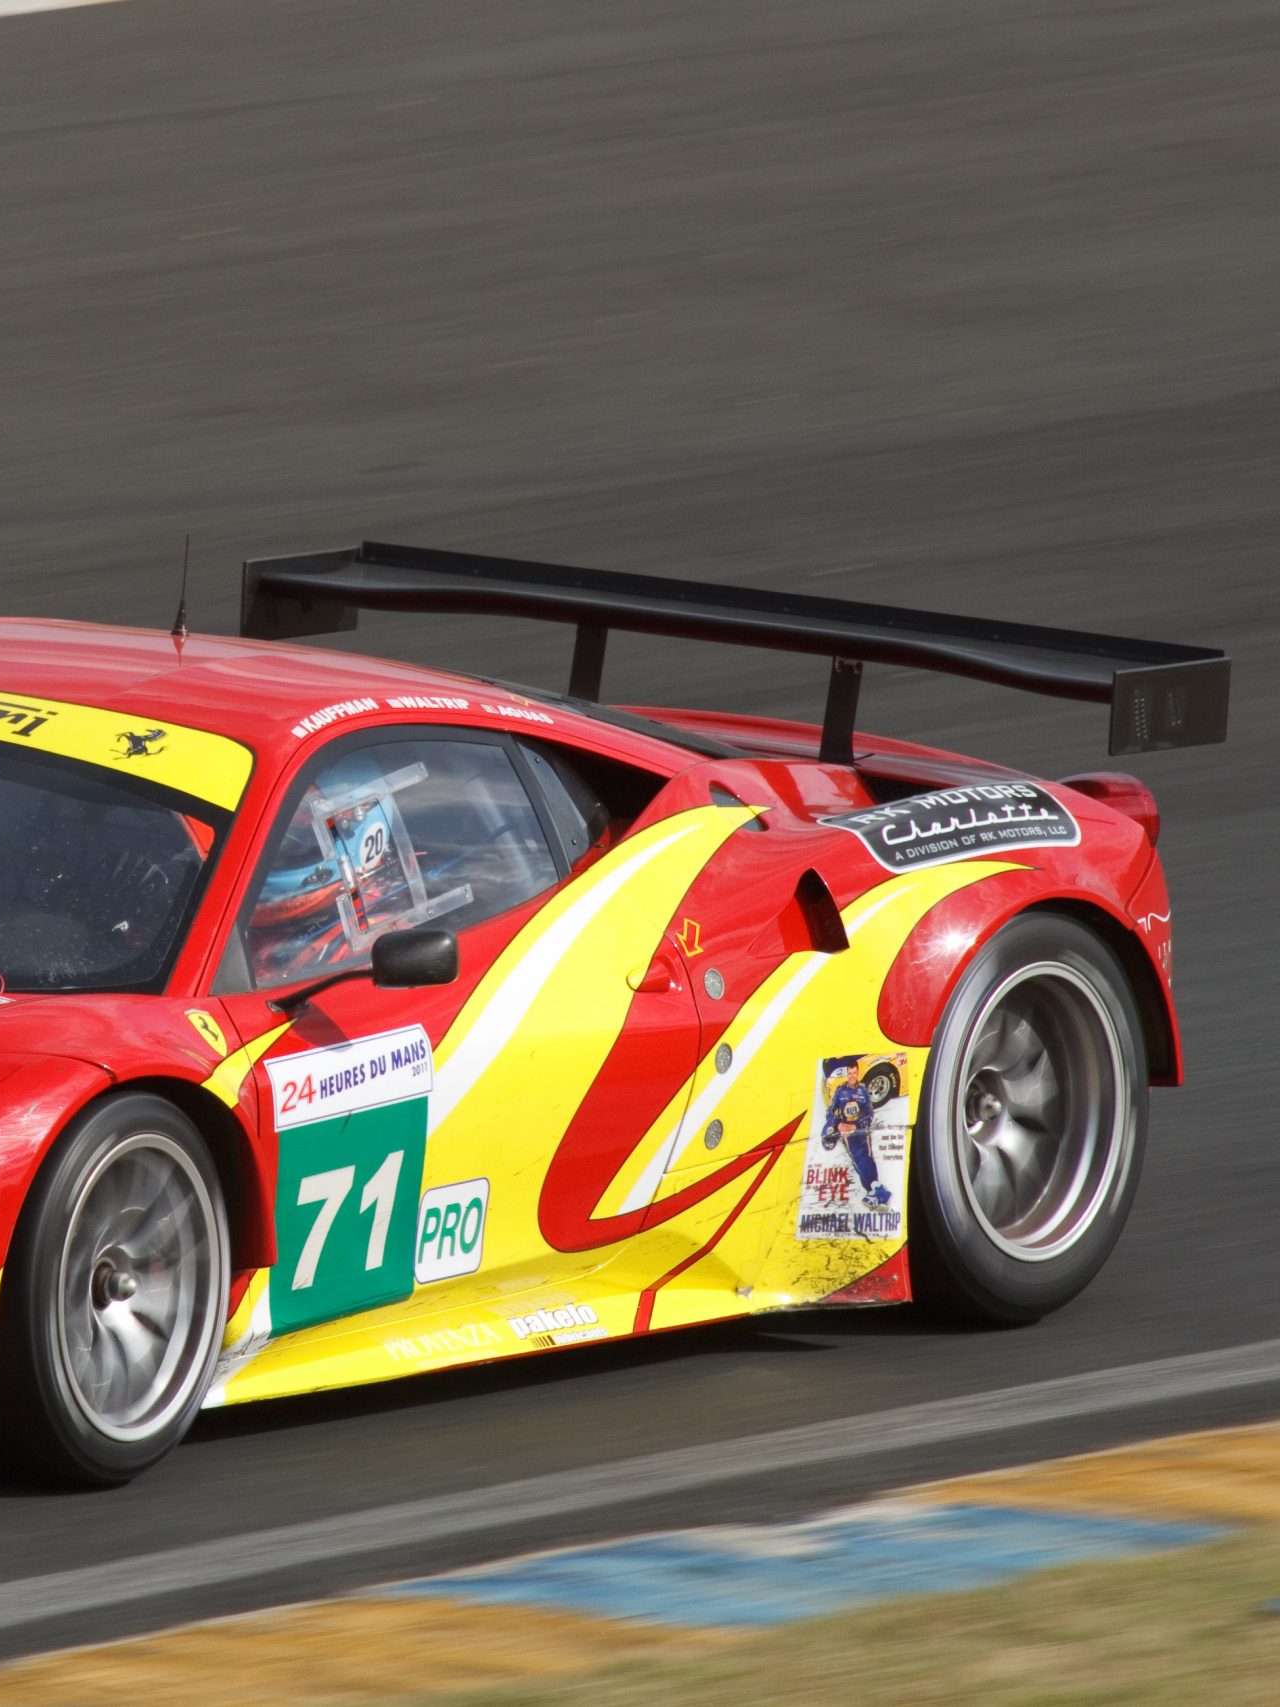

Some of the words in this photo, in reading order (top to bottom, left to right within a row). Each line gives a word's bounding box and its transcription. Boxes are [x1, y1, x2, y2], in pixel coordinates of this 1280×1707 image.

[302, 697, 379, 733] KAUFFMAN
[399, 697, 470, 710] WALTRIP
[850, 804, 910, 824] RK
[917, 785, 1037, 809] MOTORS
[882, 803, 1059, 845] Charlotte
[895, 851, 905, 862] A
[907, 840, 959, 859] DIVISION
[961, 834, 976, 846] OF
[980, 831, 997, 843] RK
[999, 826, 1047, 841] MOTORS,
[1049, 824, 1068, 836] LLC
[364, 828, 384, 863] 20
[280, 1072, 317, 1116] 24
[320, 1063, 366, 1100] HEURES
[370, 1055, 387, 1080] DU
[391, 1038, 427, 1072] MANS
[807, 1167, 849, 1185] BLINK
[818, 1183, 849, 1202] EYE
[290, 1149, 406, 1292] 71
[417, 1195, 485, 1262] PRO
[854, 1212, 901, 1232] WALTRIP
[507, 1302, 600, 1340] pakelo
